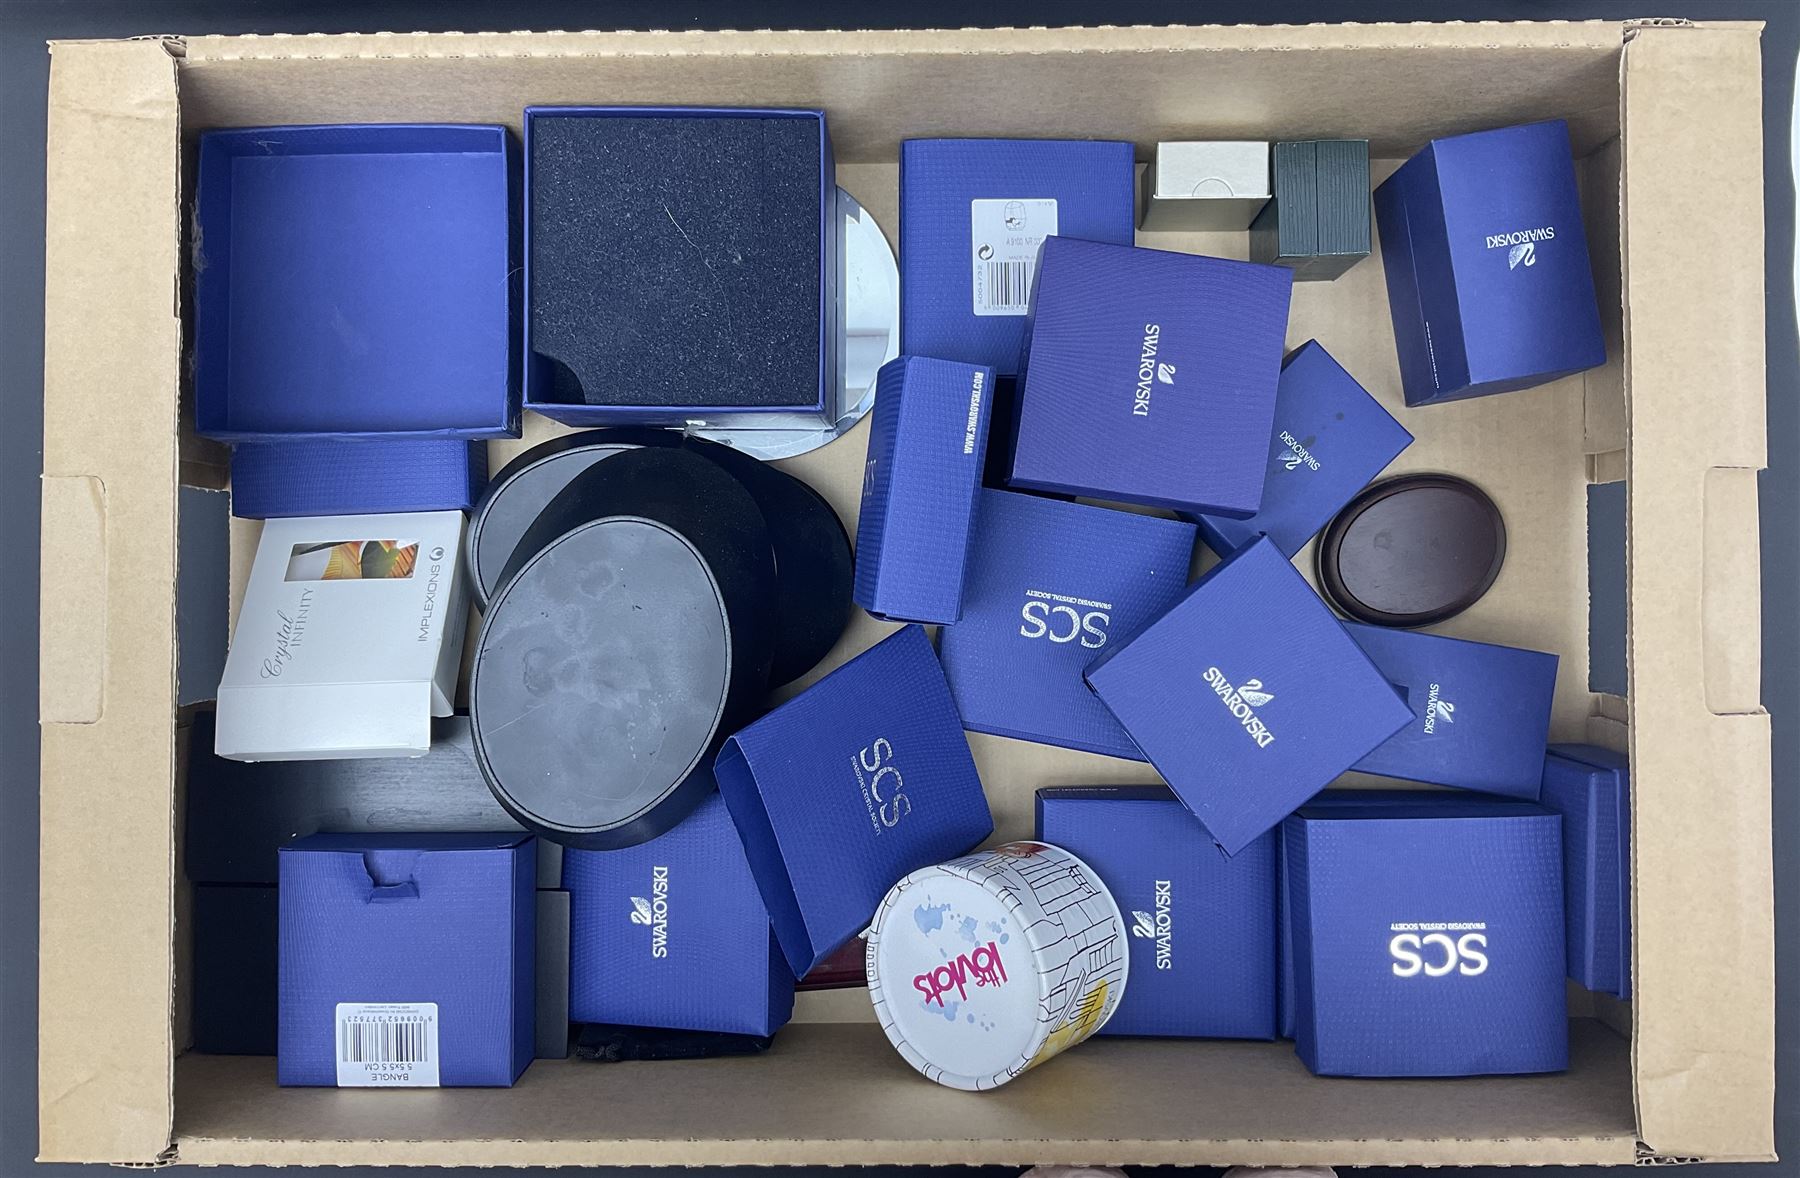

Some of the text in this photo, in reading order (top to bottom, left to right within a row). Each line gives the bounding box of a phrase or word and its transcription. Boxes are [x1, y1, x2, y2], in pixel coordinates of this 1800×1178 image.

[1486, 226, 1555, 248] SWAROVSKI
[1133, 323, 1160, 416] SWAROVSKI
[964, 372, 984, 455] WWW.SWAROVSKI.COM
[1280, 431, 1320, 470] SWAROVSKI
[290, 587, 314, 647] INFINITY
[417, 564, 441, 642] IMPLEXIONS
[1021, 601, 1110, 648] SCS
[1026, 589, 1112, 610] SWAROVSKI CRYSTAL SOCIETY
[260, 610, 294, 679] Crystal
[1203, 666, 1275, 748] SWAROVSKI
[1424, 683, 1439, 734] SWAROVSKI
[860, 738, 912, 827] SCS
[862, 788, 873, 813] CRYSTAL
[653, 866, 668, 958] SWAROVSKI
[1155, 880, 1171, 969] SWAROVSKI
[1390, 922, 1486, 930] SWAROVSKI CRYSTAL SOCIETY
[976, 970, 1001, 988] the
[1390, 933, 1488, 977] SCS
[372, 1073, 409, 1081] BANGLE
